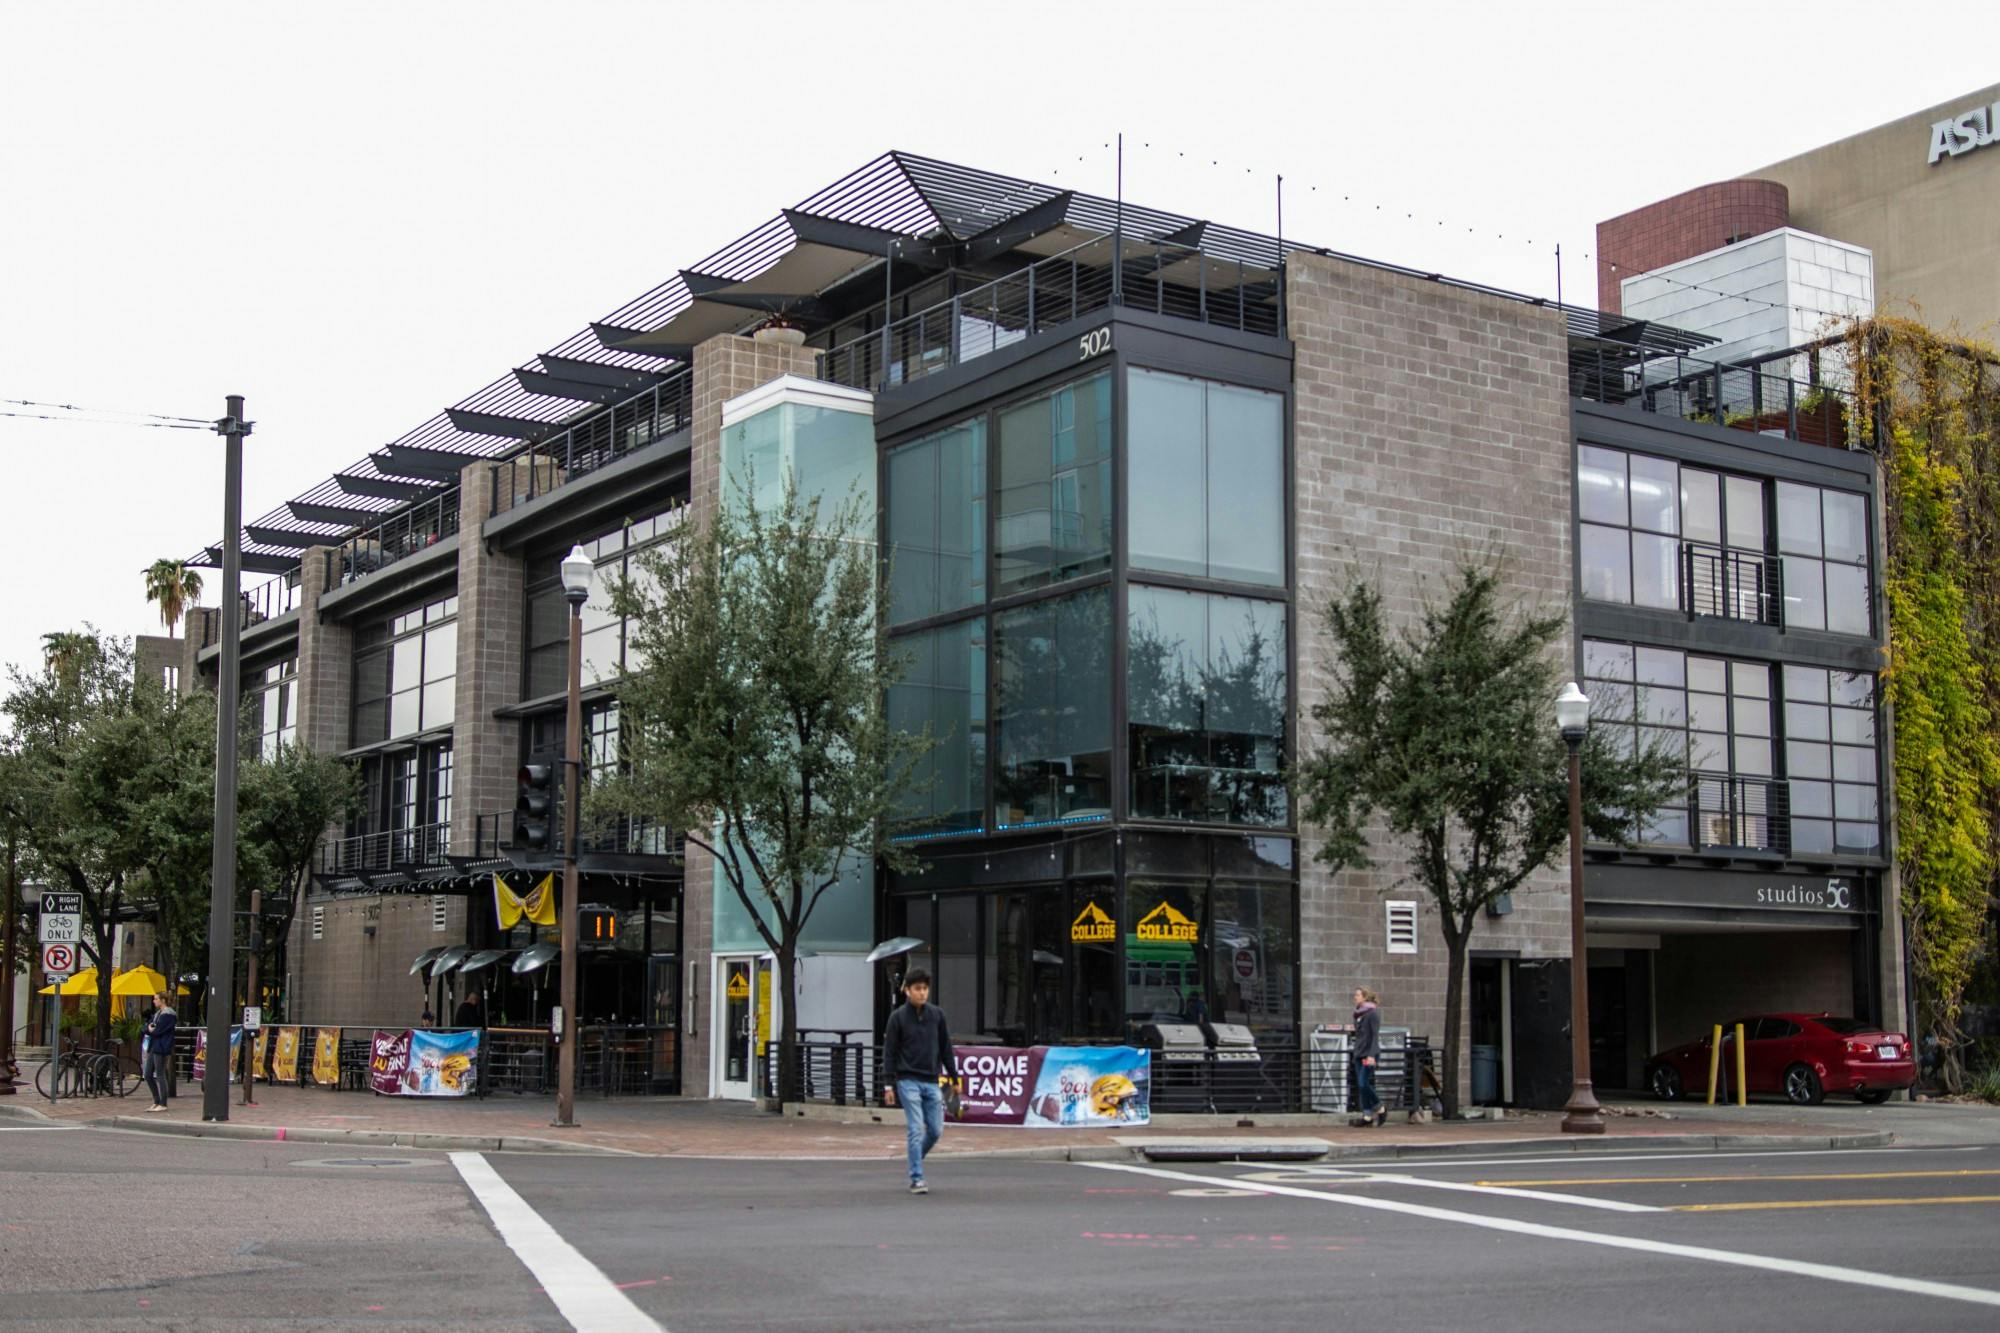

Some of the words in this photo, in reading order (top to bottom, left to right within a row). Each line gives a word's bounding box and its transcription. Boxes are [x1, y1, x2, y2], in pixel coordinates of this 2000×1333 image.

[1928, 101, 2000, 164] ASU
[1080, 327, 1110, 360] 502
[1757, 885, 1824, 904] studios
[48, 930, 73, 939] ONLY
[596, 915, 615, 938] 11
[1071, 924, 1116, 940] COLLEGE
[1137, 924, 1198, 940] COLLEGE
[942, 1055, 1028, 1076] LCOME
[968, 1076, 1023, 1097] FANS
